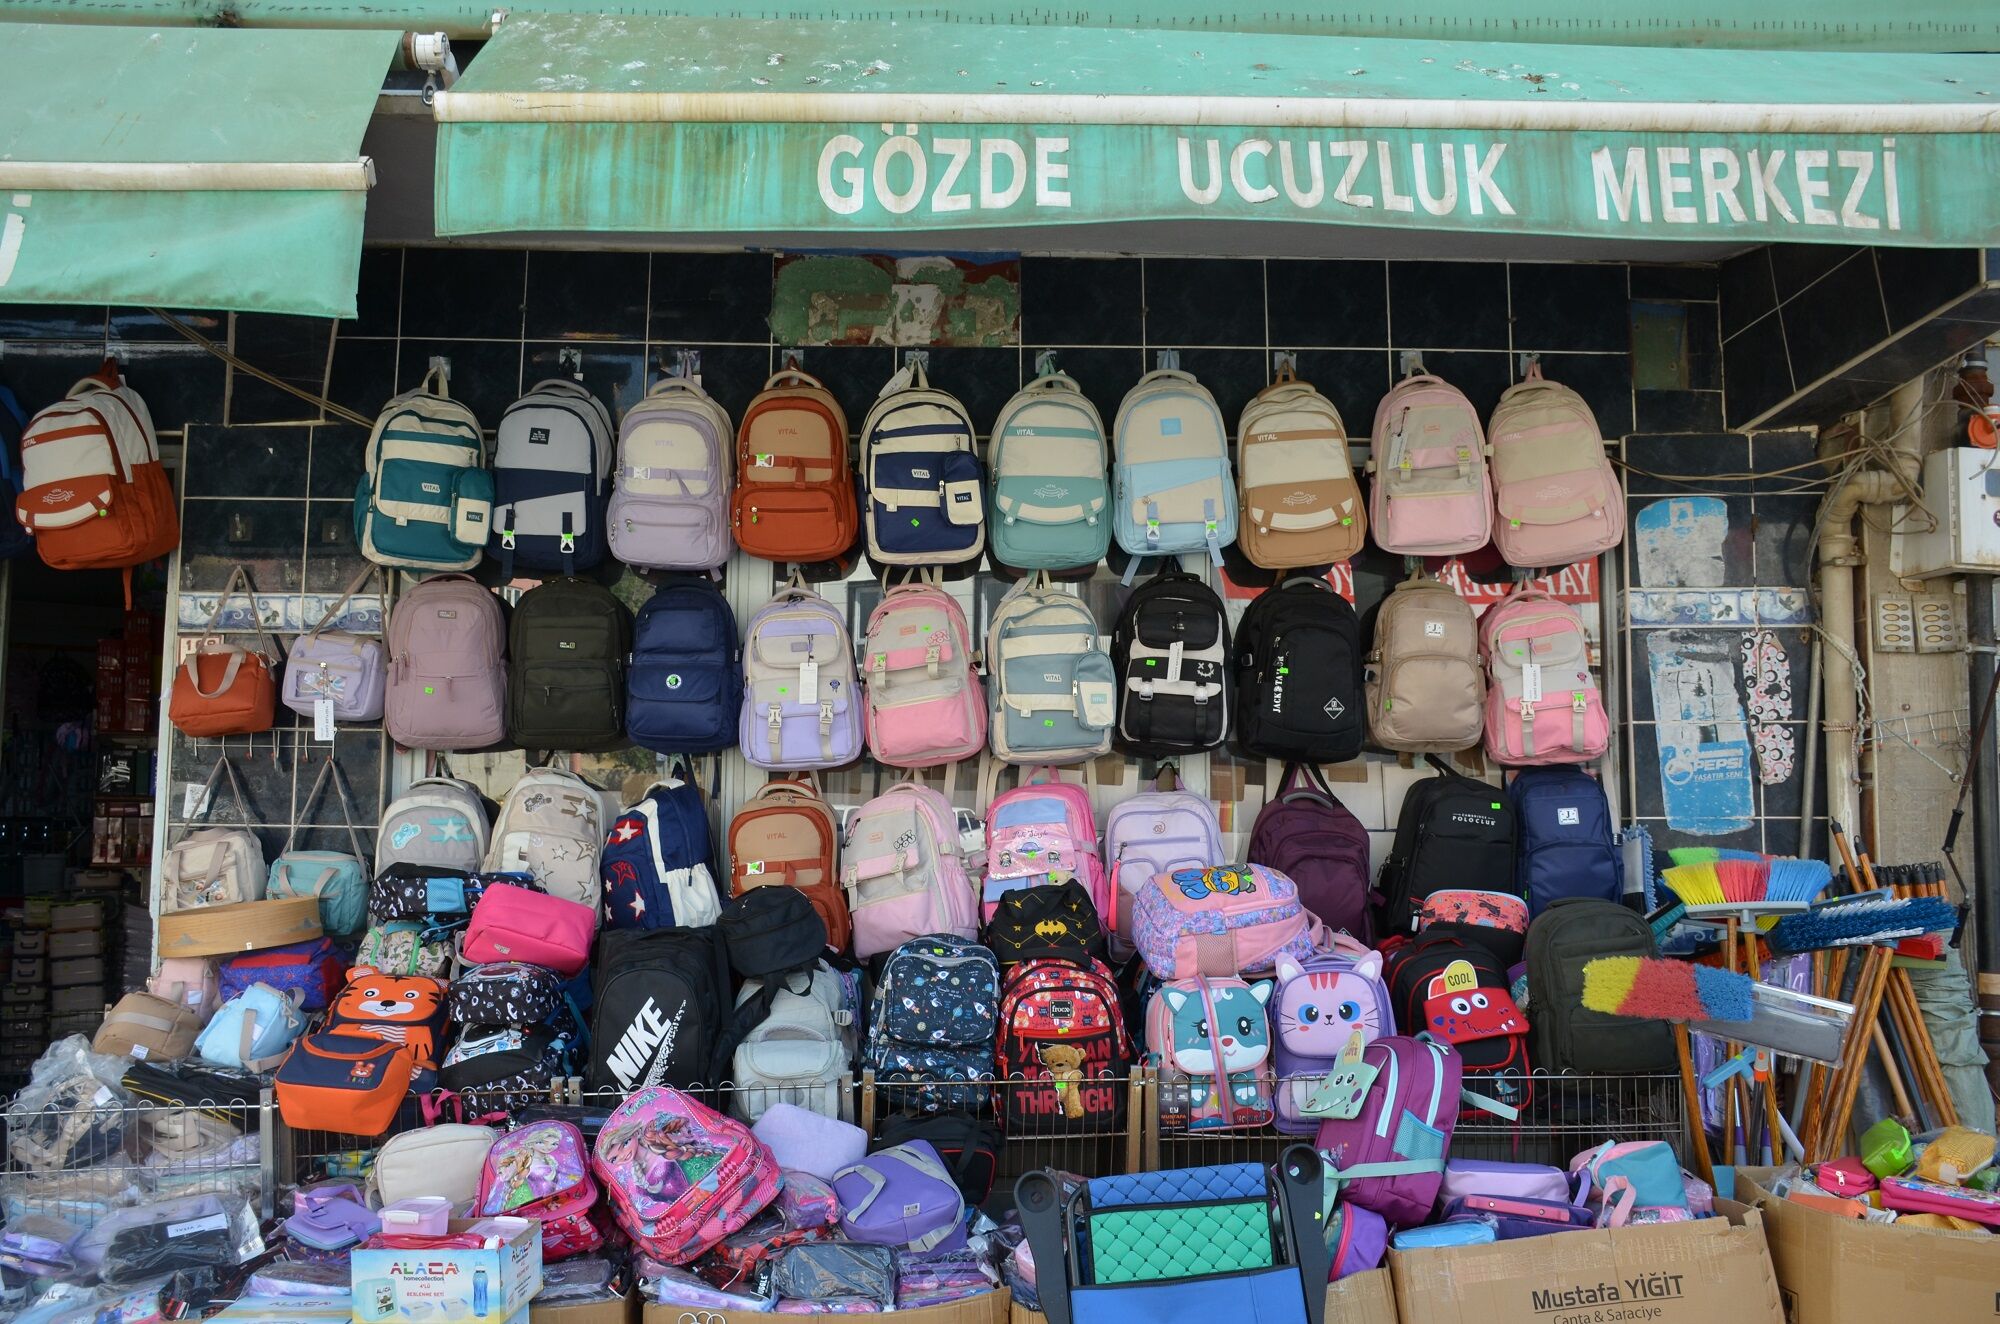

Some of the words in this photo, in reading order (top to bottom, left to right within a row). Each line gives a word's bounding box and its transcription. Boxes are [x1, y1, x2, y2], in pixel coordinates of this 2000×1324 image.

[817, 123, 1072, 214] GÖZDE
[1177, 136, 1517, 217] UCUZLUK
[1591, 138, 1901, 231] MERKEZİ
[778, 428, 798, 436] VITAL
[1016, 429, 1035, 437] VITAL
[1257, 433, 1278, 442] VITAL
[23, 437, 37, 447] VITAL
[423, 484, 439, 492] VITAL
[1045, 674, 1061, 682] VITAL
[1272, 692, 1282, 713] JACK
[1693, 757, 1744, 771] PEPSI
[766, 832, 787, 840] VITAL
[1447, 972, 1472, 987] COOL
[606, 996, 672, 1089] NIKE
[390, 1262, 459, 1275] ALACA
[1532, 1282, 1620, 1311] Mustafa
[1624, 1271, 1684, 1299] YİĞİT
[1594, 1310, 1604, 1322] &
[1607, 1305, 1662, 1322] Saraciye
